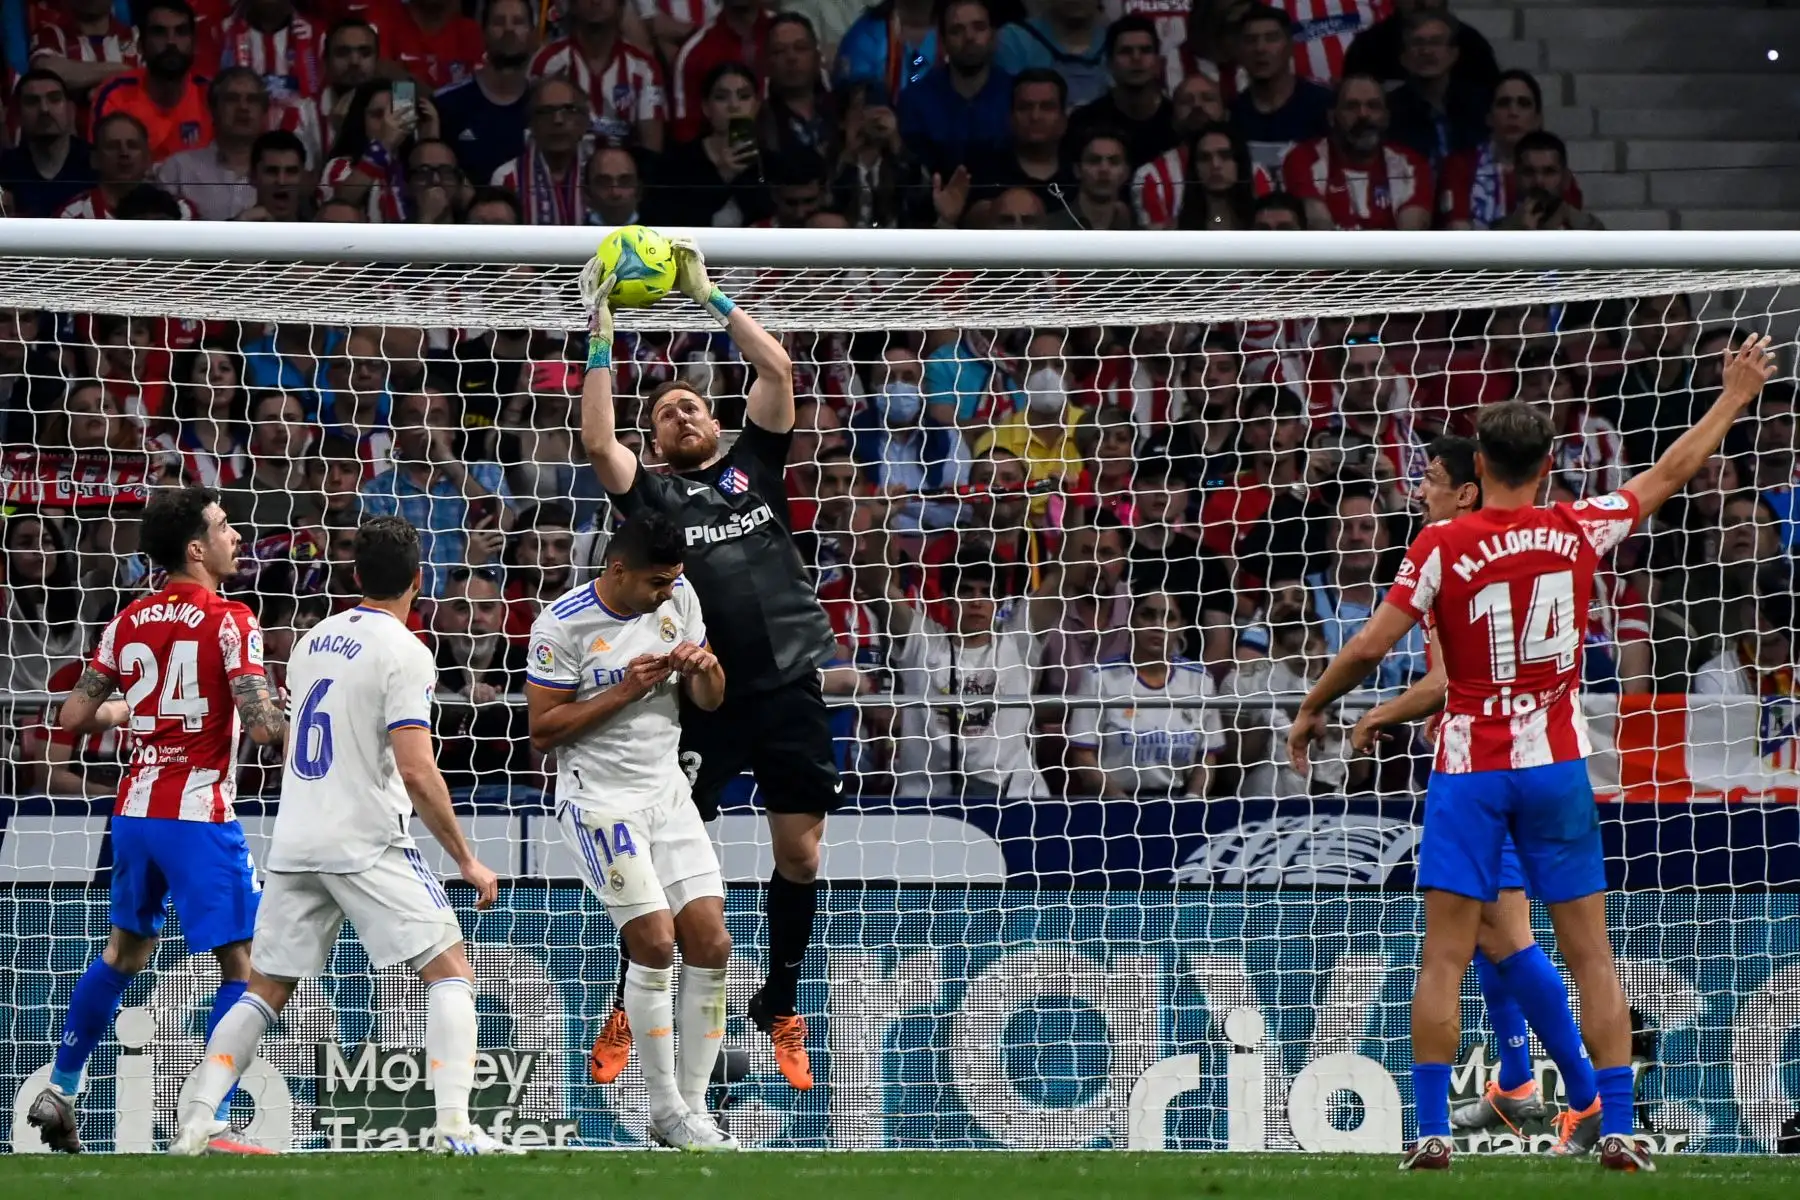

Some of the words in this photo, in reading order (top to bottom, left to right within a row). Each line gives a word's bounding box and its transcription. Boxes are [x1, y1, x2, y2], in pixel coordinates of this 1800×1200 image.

[1452, 554, 1486, 582] M.
[1478, 527, 1580, 563] LLORENTE
[308, 634, 362, 661] NACHO
[1469, 570, 1580, 684] 14
[119, 640, 209, 734] 24
[1483, 686, 1536, 716] rio
[291, 678, 334, 781] 6
[594, 822, 637, 867] 14
[326, 1047, 533, 1103] Moey
[1128, 1006, 1403, 1152] rio
[320, 1110, 577, 1150] Trafer
